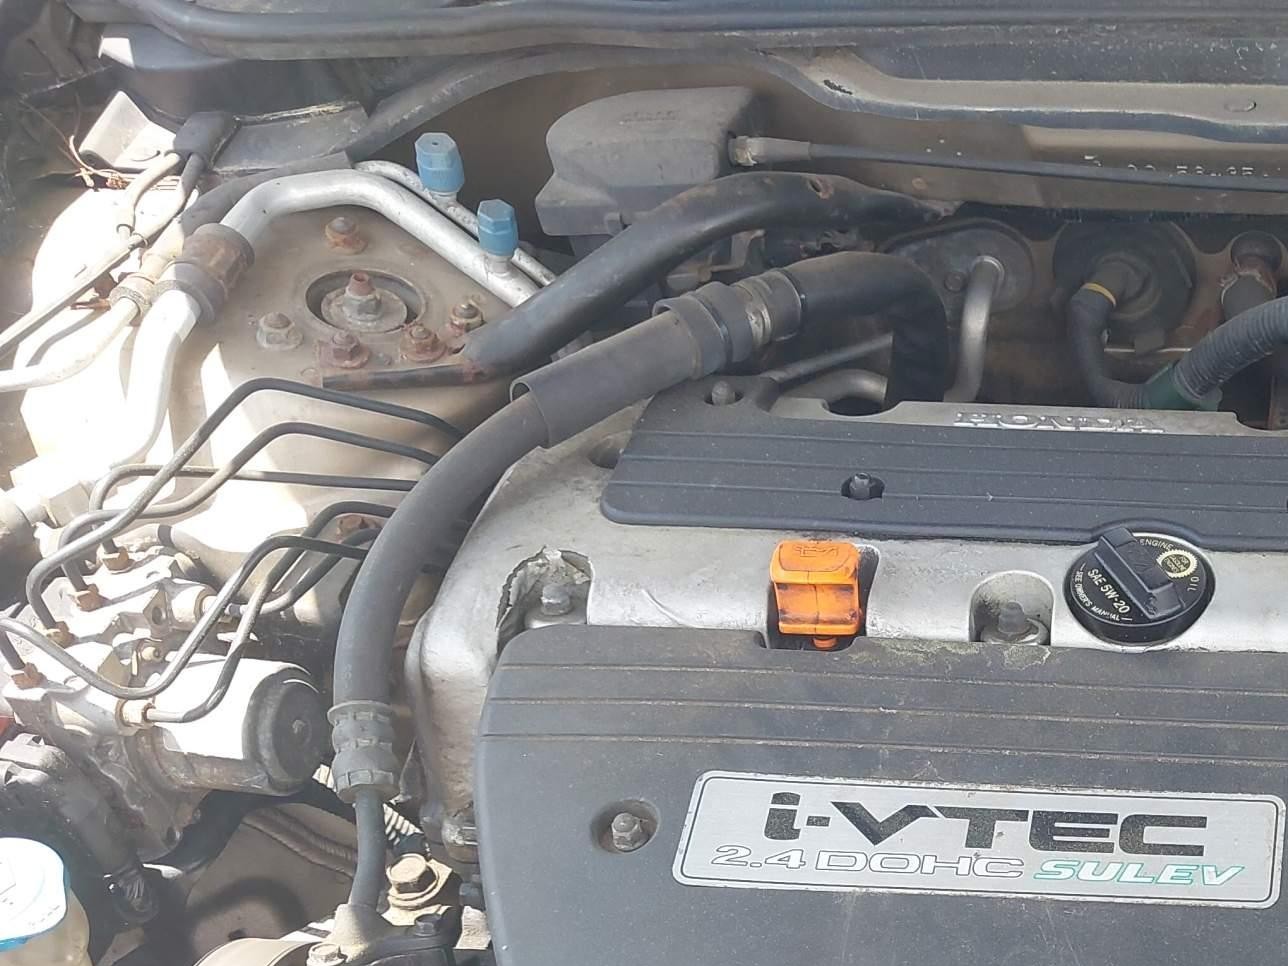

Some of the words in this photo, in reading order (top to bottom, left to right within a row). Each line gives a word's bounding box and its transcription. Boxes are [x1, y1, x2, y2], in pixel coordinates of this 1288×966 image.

[954, 411, 1165, 433] HONDA
[1139, 538, 1174, 550] ENGINE
[1074, 571, 1083, 584] SEE
[1091, 606, 1121, 621] MANUAL
[1087, 568, 1103, 586] SAE
[1100, 583, 1131, 614] 5W-20
[1187, 576, 1200, 592] OIL
[764, 792, 1208, 856] i-VTEC
[711, 844, 806, 870] 2.4
[816, 849, 1025, 879] DOHC
[1033, 860, 1247, 887] SULEV
